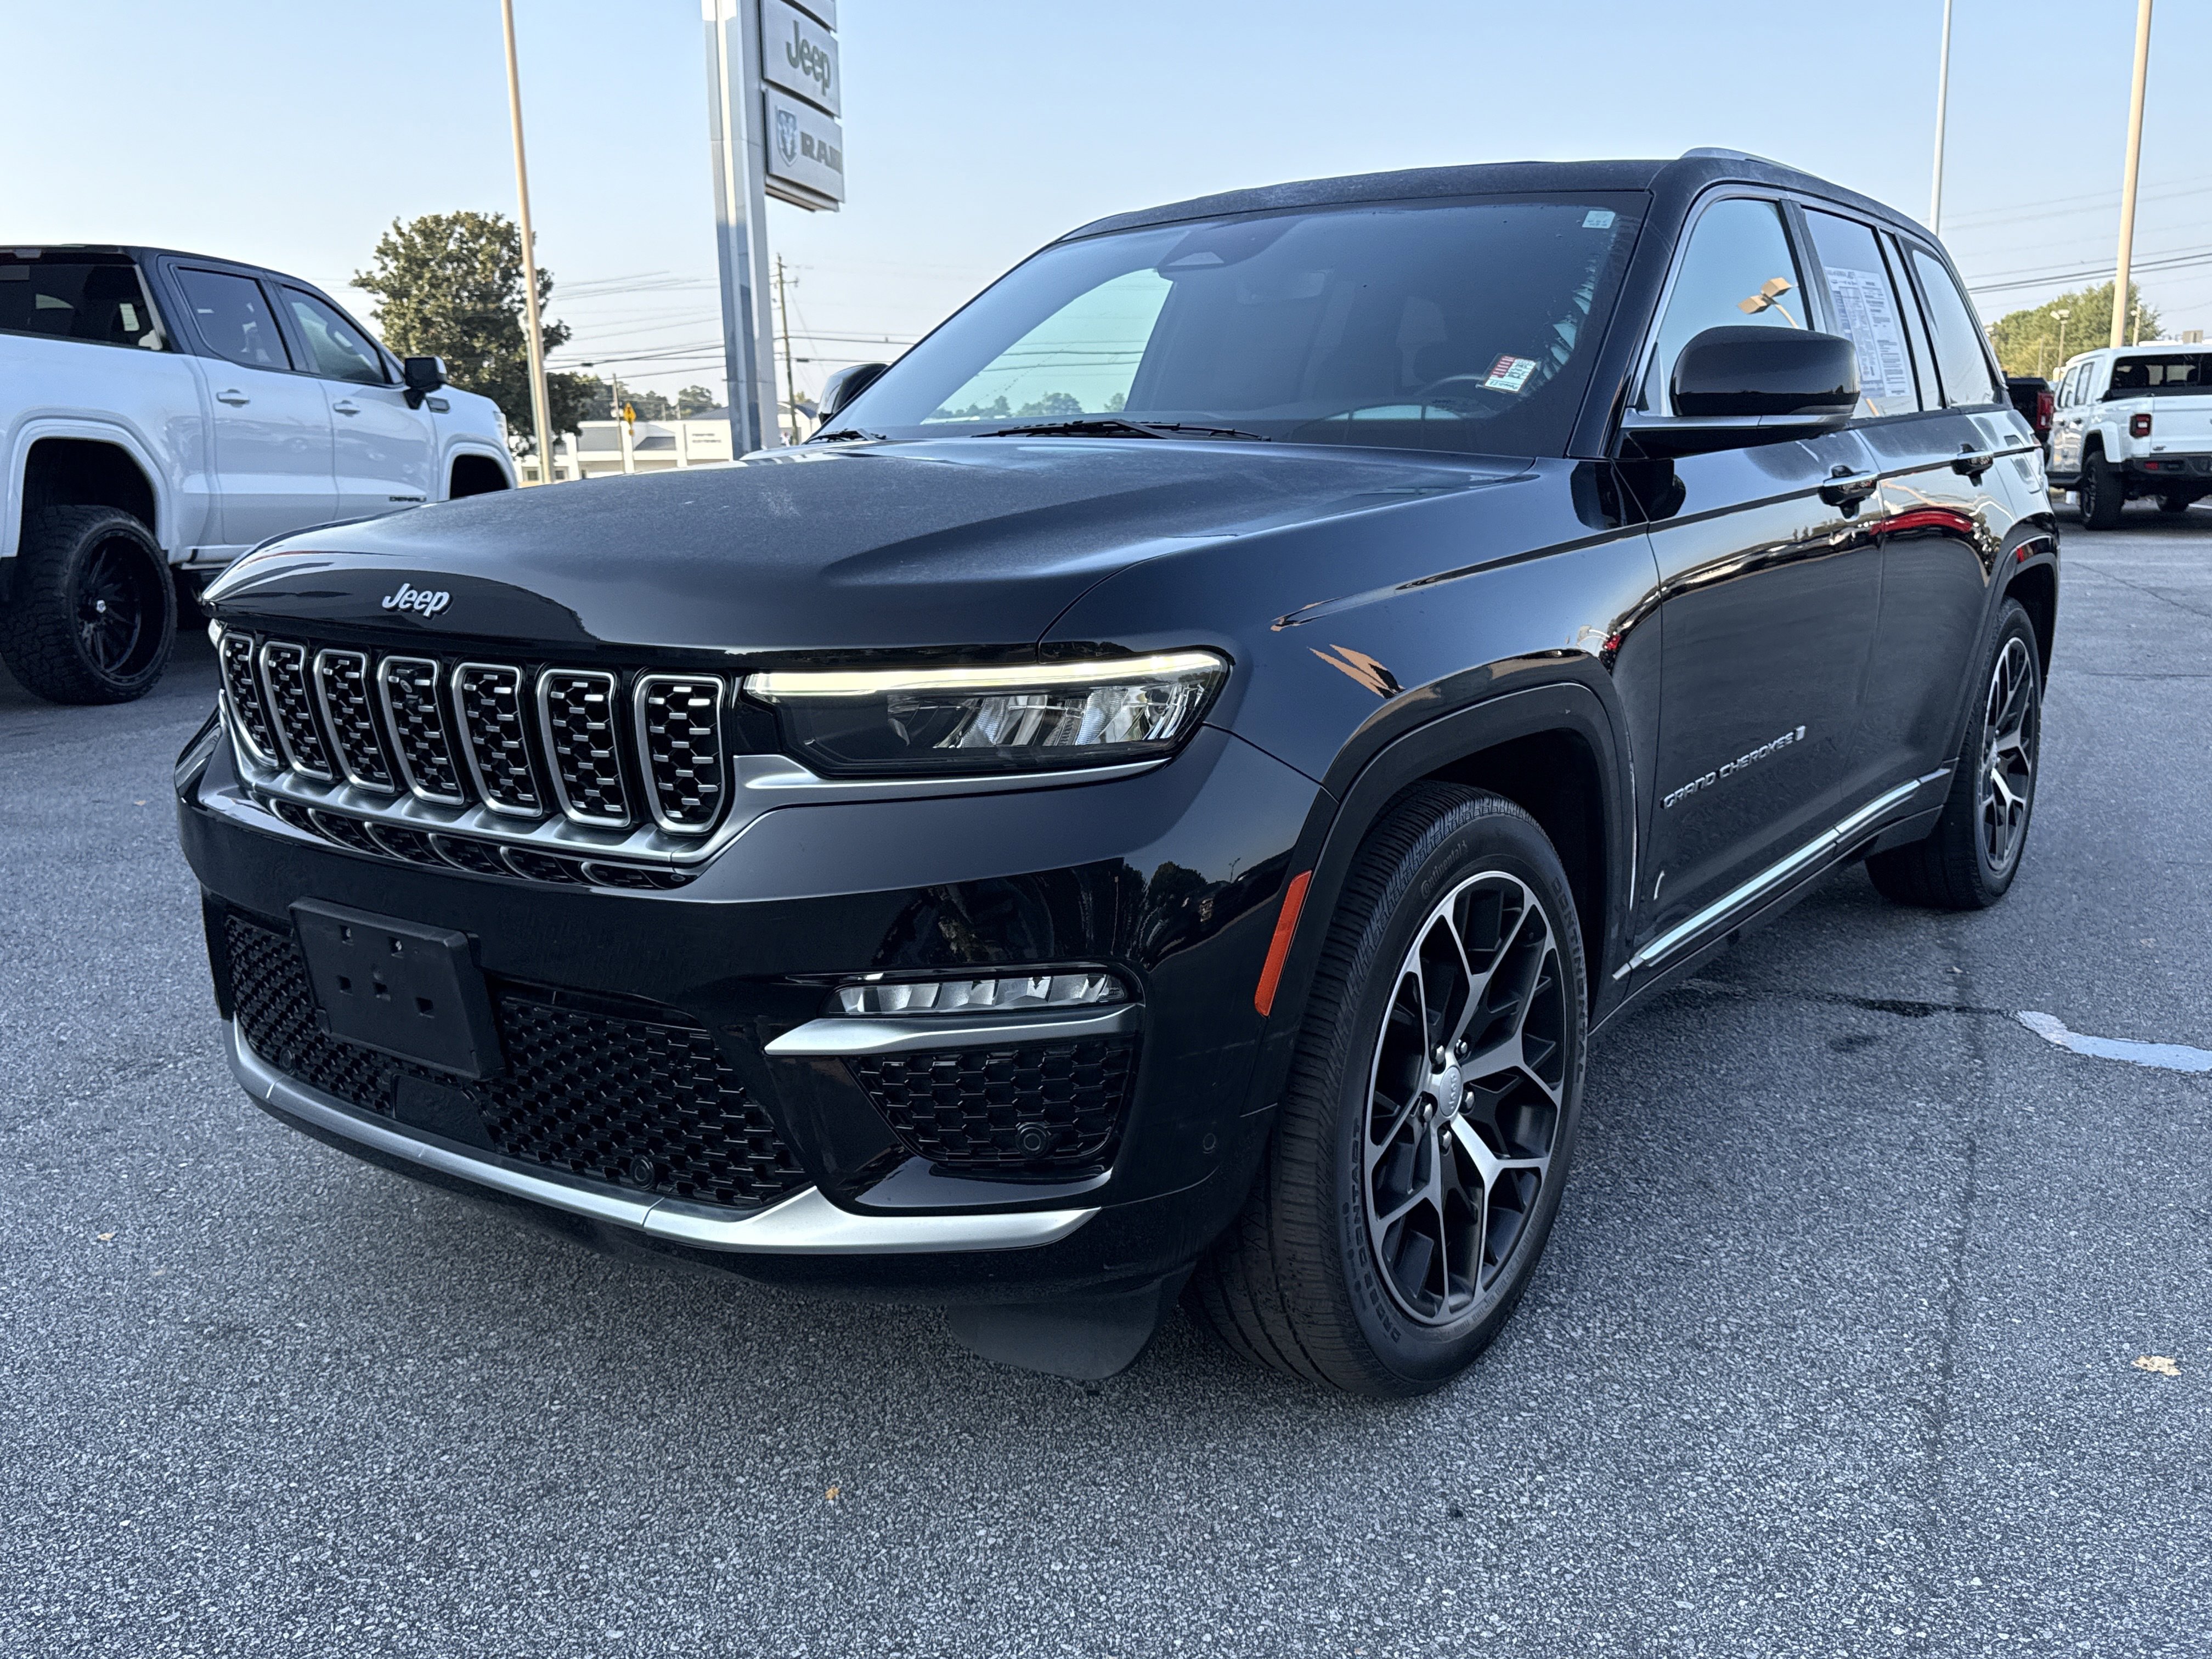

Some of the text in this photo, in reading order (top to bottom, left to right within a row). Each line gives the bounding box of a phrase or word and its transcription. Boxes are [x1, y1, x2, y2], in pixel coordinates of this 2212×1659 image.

[786, 20, 831, 97] Jeep
[381, 583, 450, 618] Jeep
[1663, 731, 1794, 809] GRAND CHEROKEE
[1421, 843, 1462, 900] Continental
